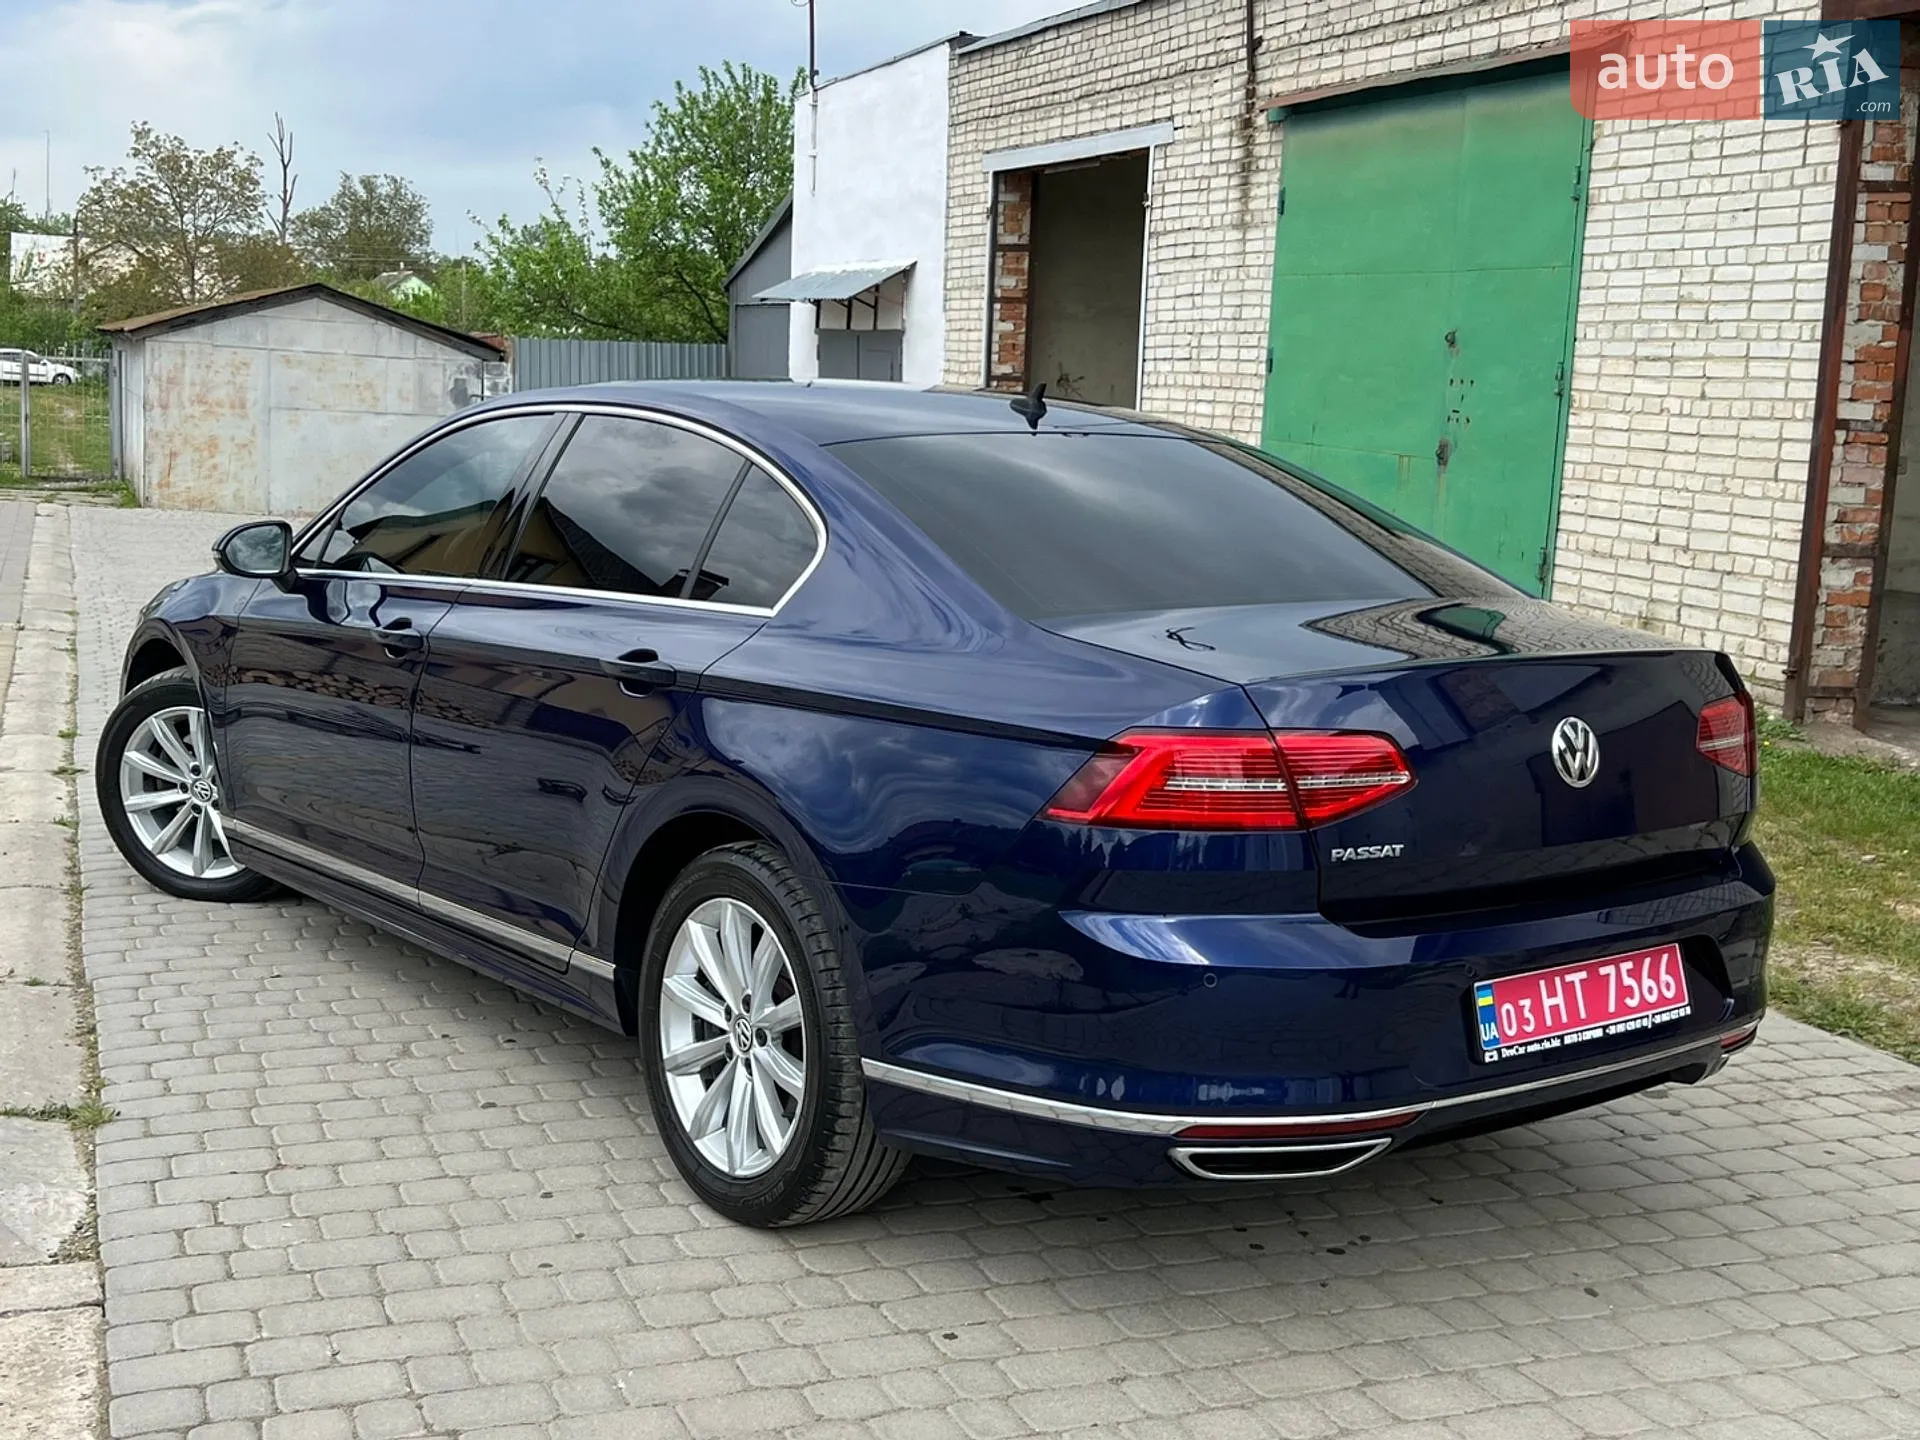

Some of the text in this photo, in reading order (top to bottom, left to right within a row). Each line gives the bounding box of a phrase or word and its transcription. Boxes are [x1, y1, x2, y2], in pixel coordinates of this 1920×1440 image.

[1331, 844, 1404, 861] PASSAT
[1500, 998, 1536, 1037] 03
[1539, 971, 1588, 1027] HT
[1598, 953, 1676, 1013] 7566
[1481, 1021, 1499, 1041] UA
